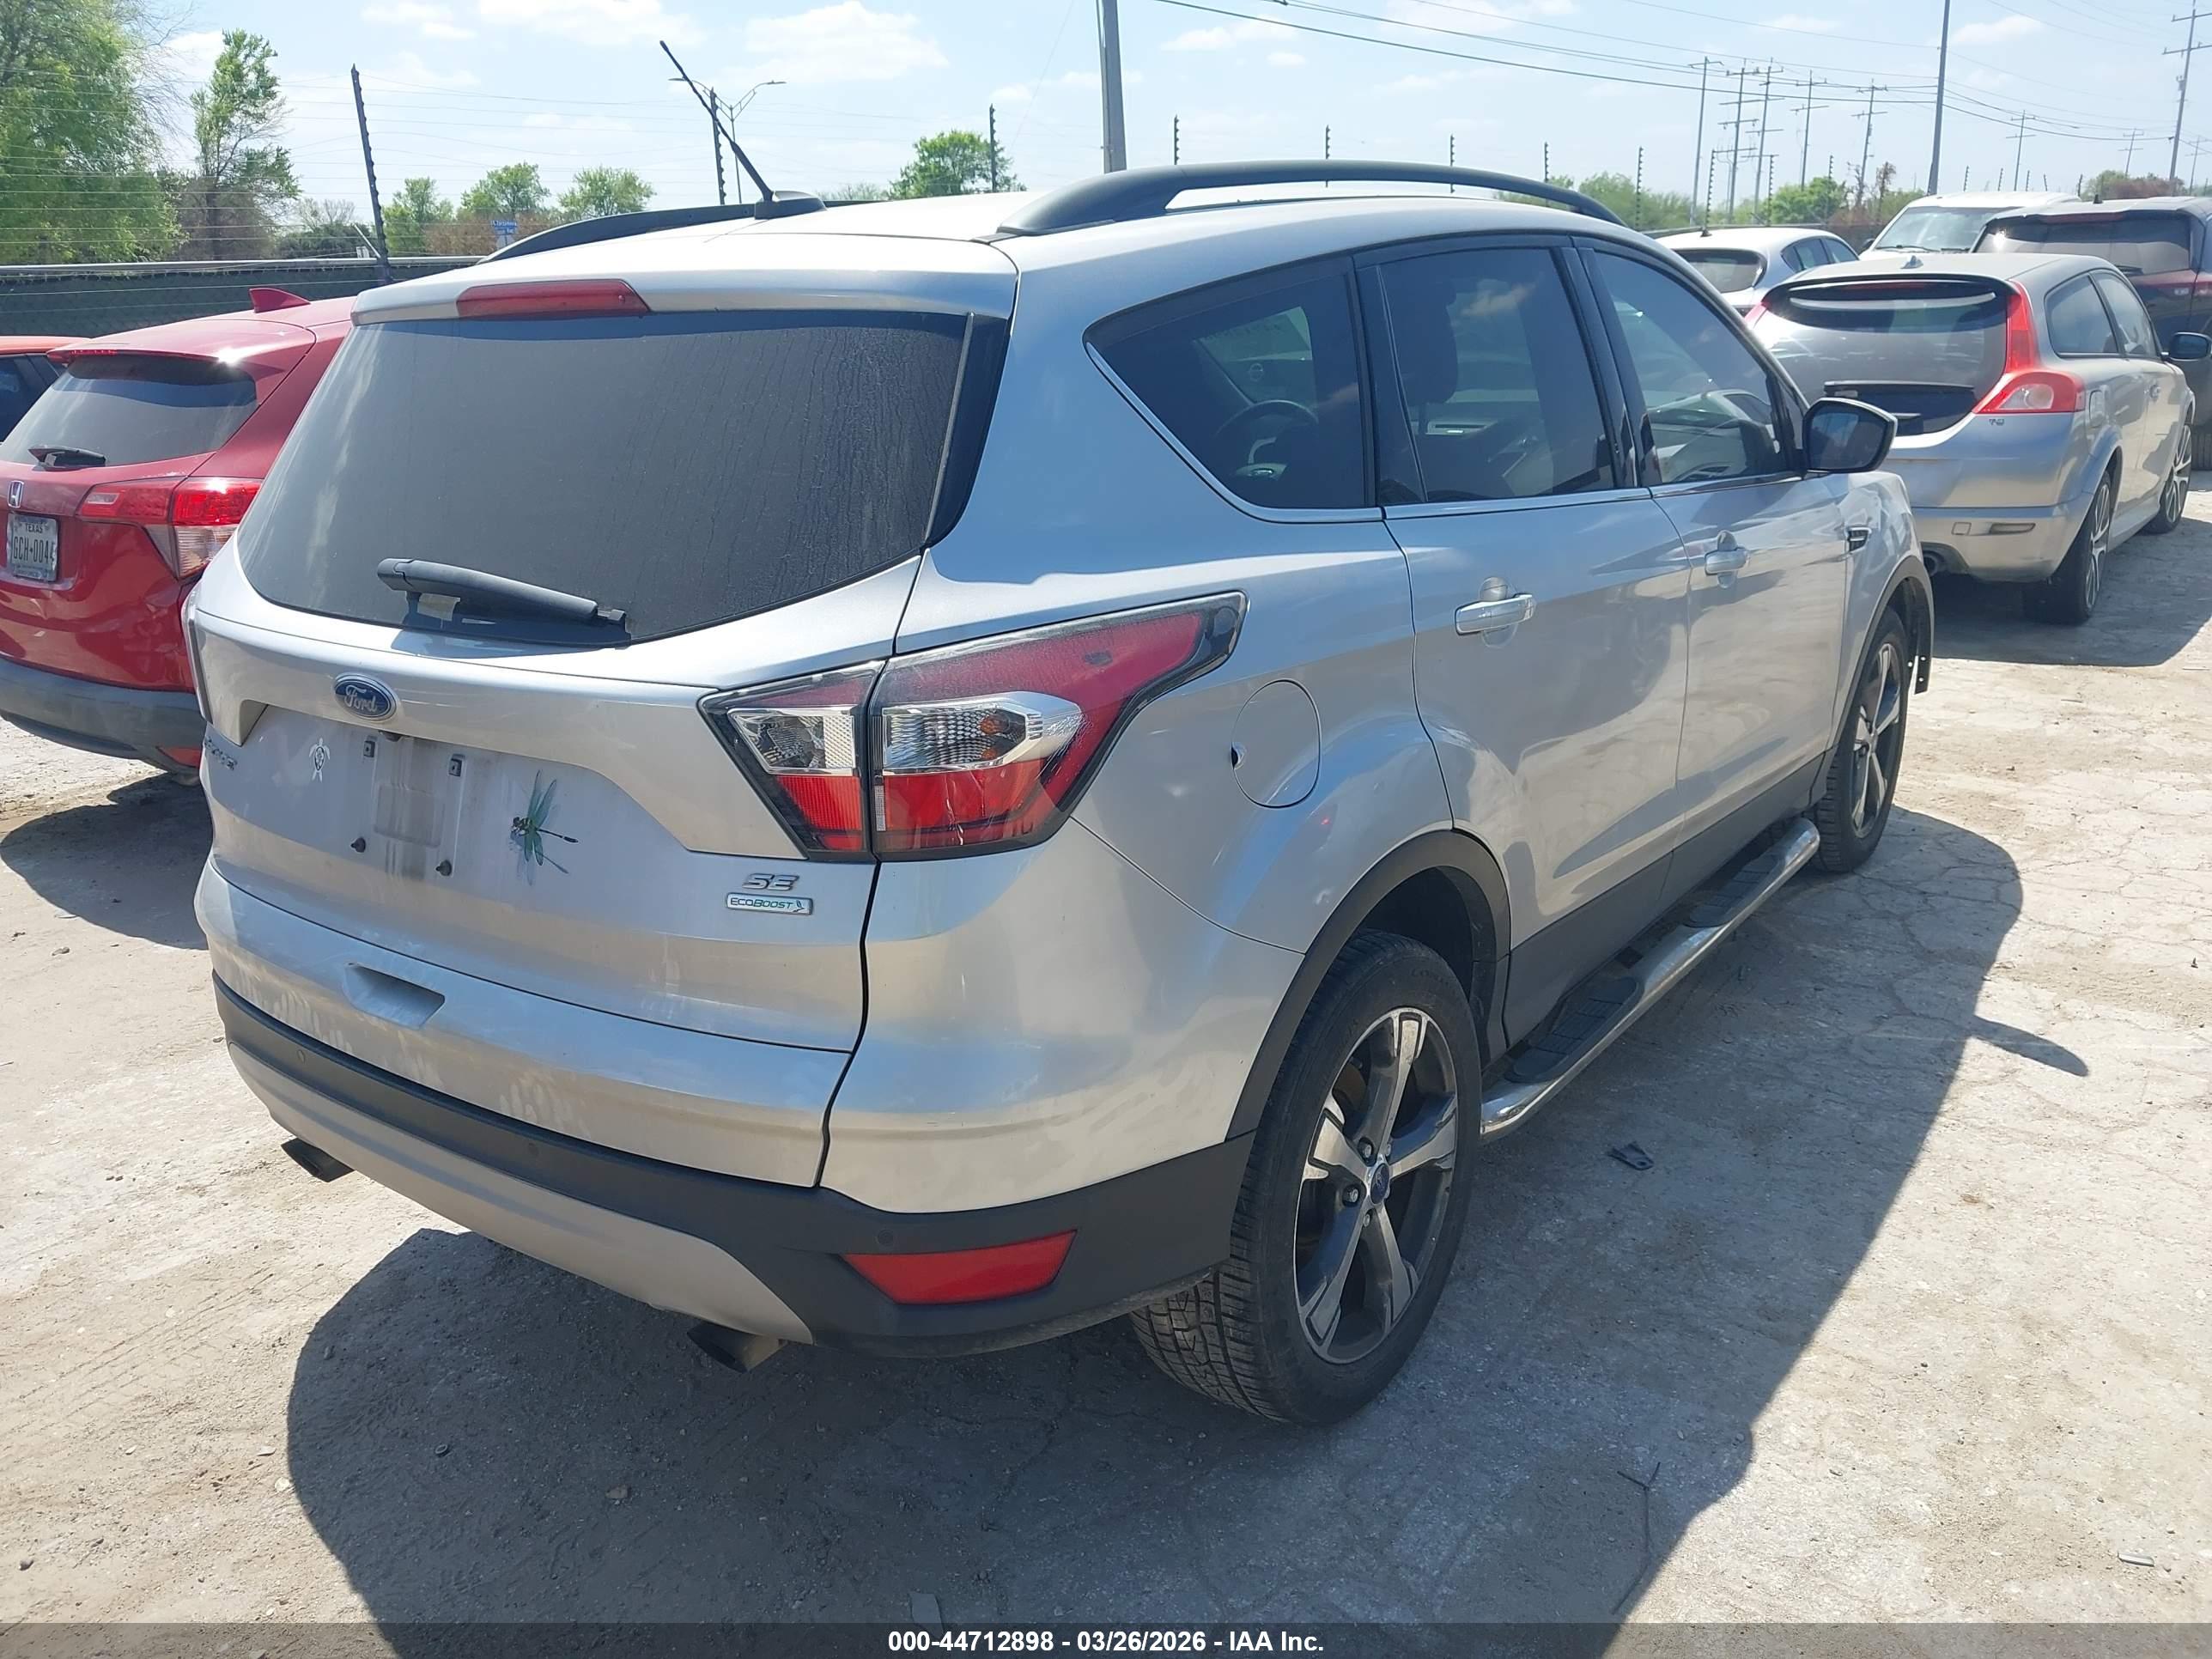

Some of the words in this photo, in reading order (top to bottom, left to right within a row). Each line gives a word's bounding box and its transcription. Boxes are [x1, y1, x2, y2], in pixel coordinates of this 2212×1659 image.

[26, 521, 44, 533] TEXAS
[344, 684, 378, 713] Ford
[742, 872, 799, 891] SE
